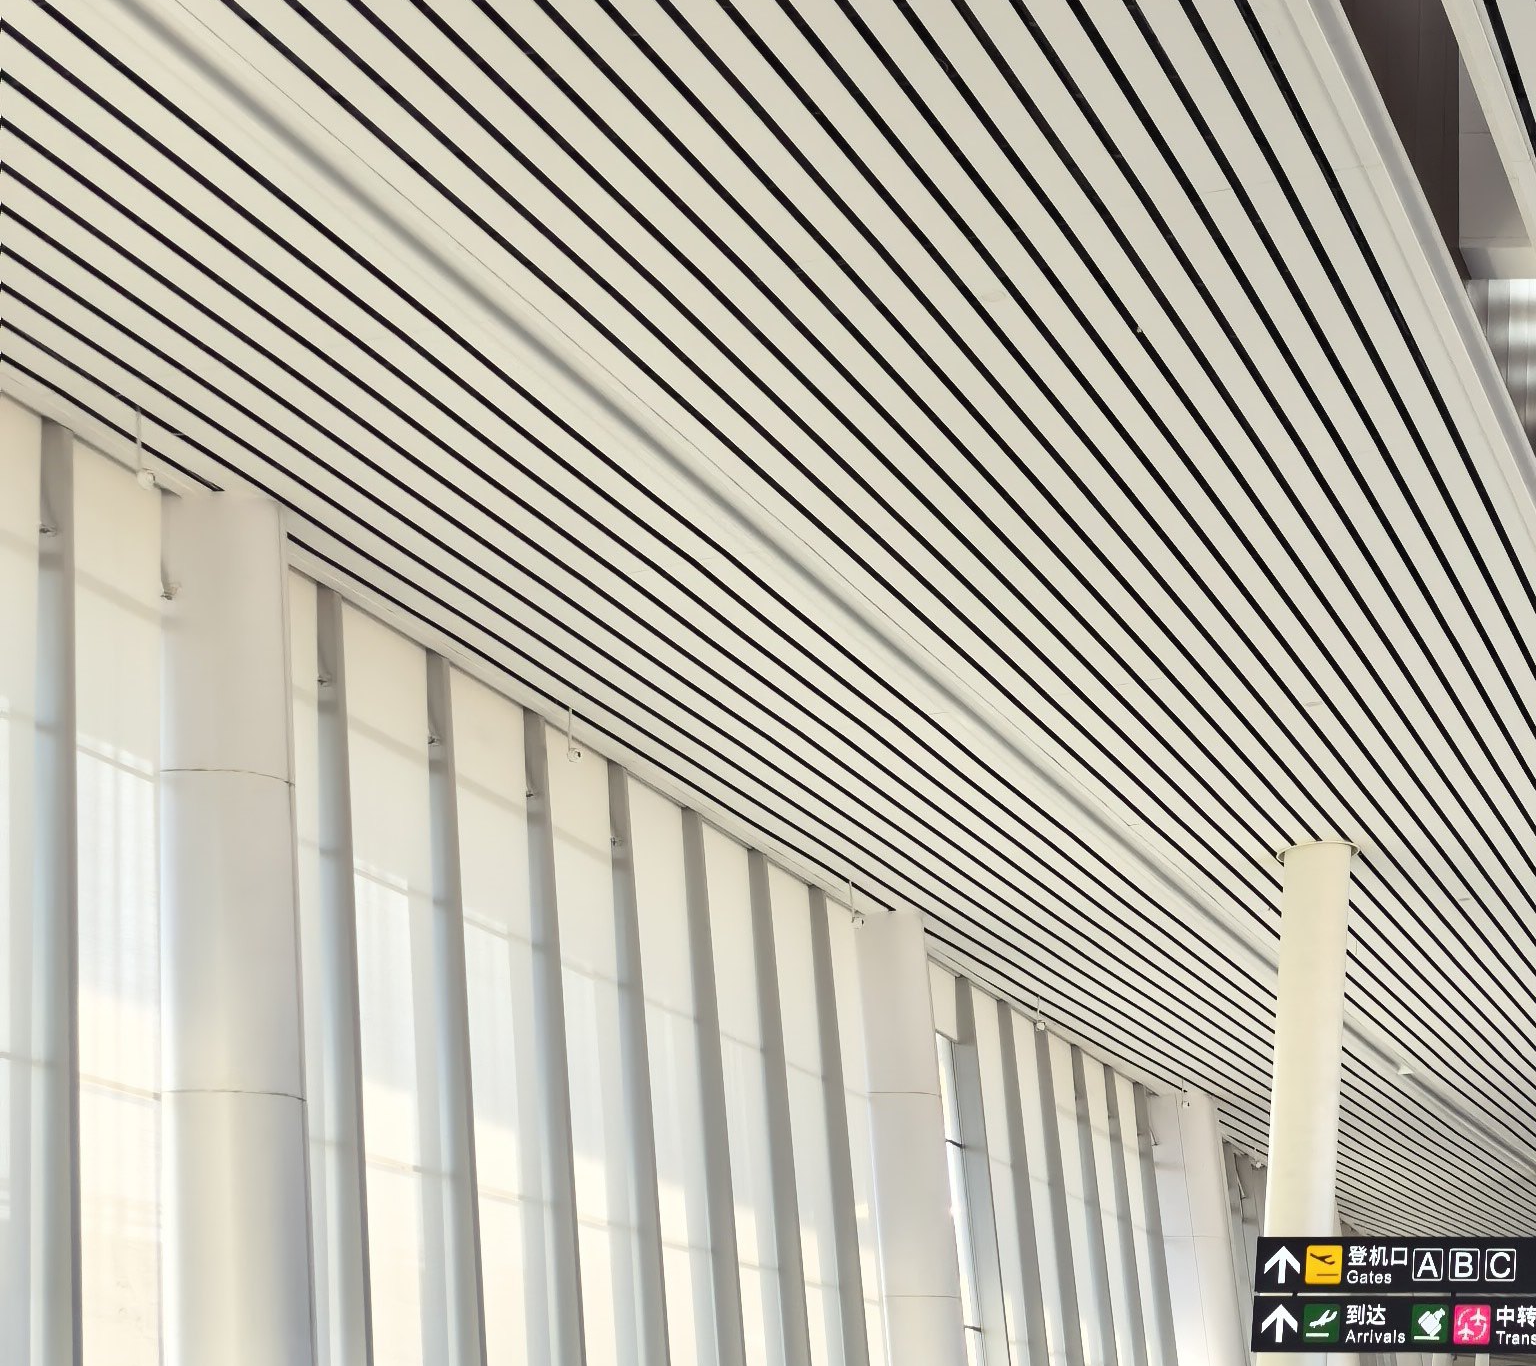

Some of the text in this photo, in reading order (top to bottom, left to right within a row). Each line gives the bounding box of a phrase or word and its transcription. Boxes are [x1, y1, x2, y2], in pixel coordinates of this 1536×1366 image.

[1347, 1244, 1408, 1267] 登机口
[1416, 1251, 1512, 1278] A B C
[1346, 1269, 1393, 1285] Gates
[1345, 1303, 1387, 1326] 到达
[1345, 1329, 1406, 1344] Arrivals
